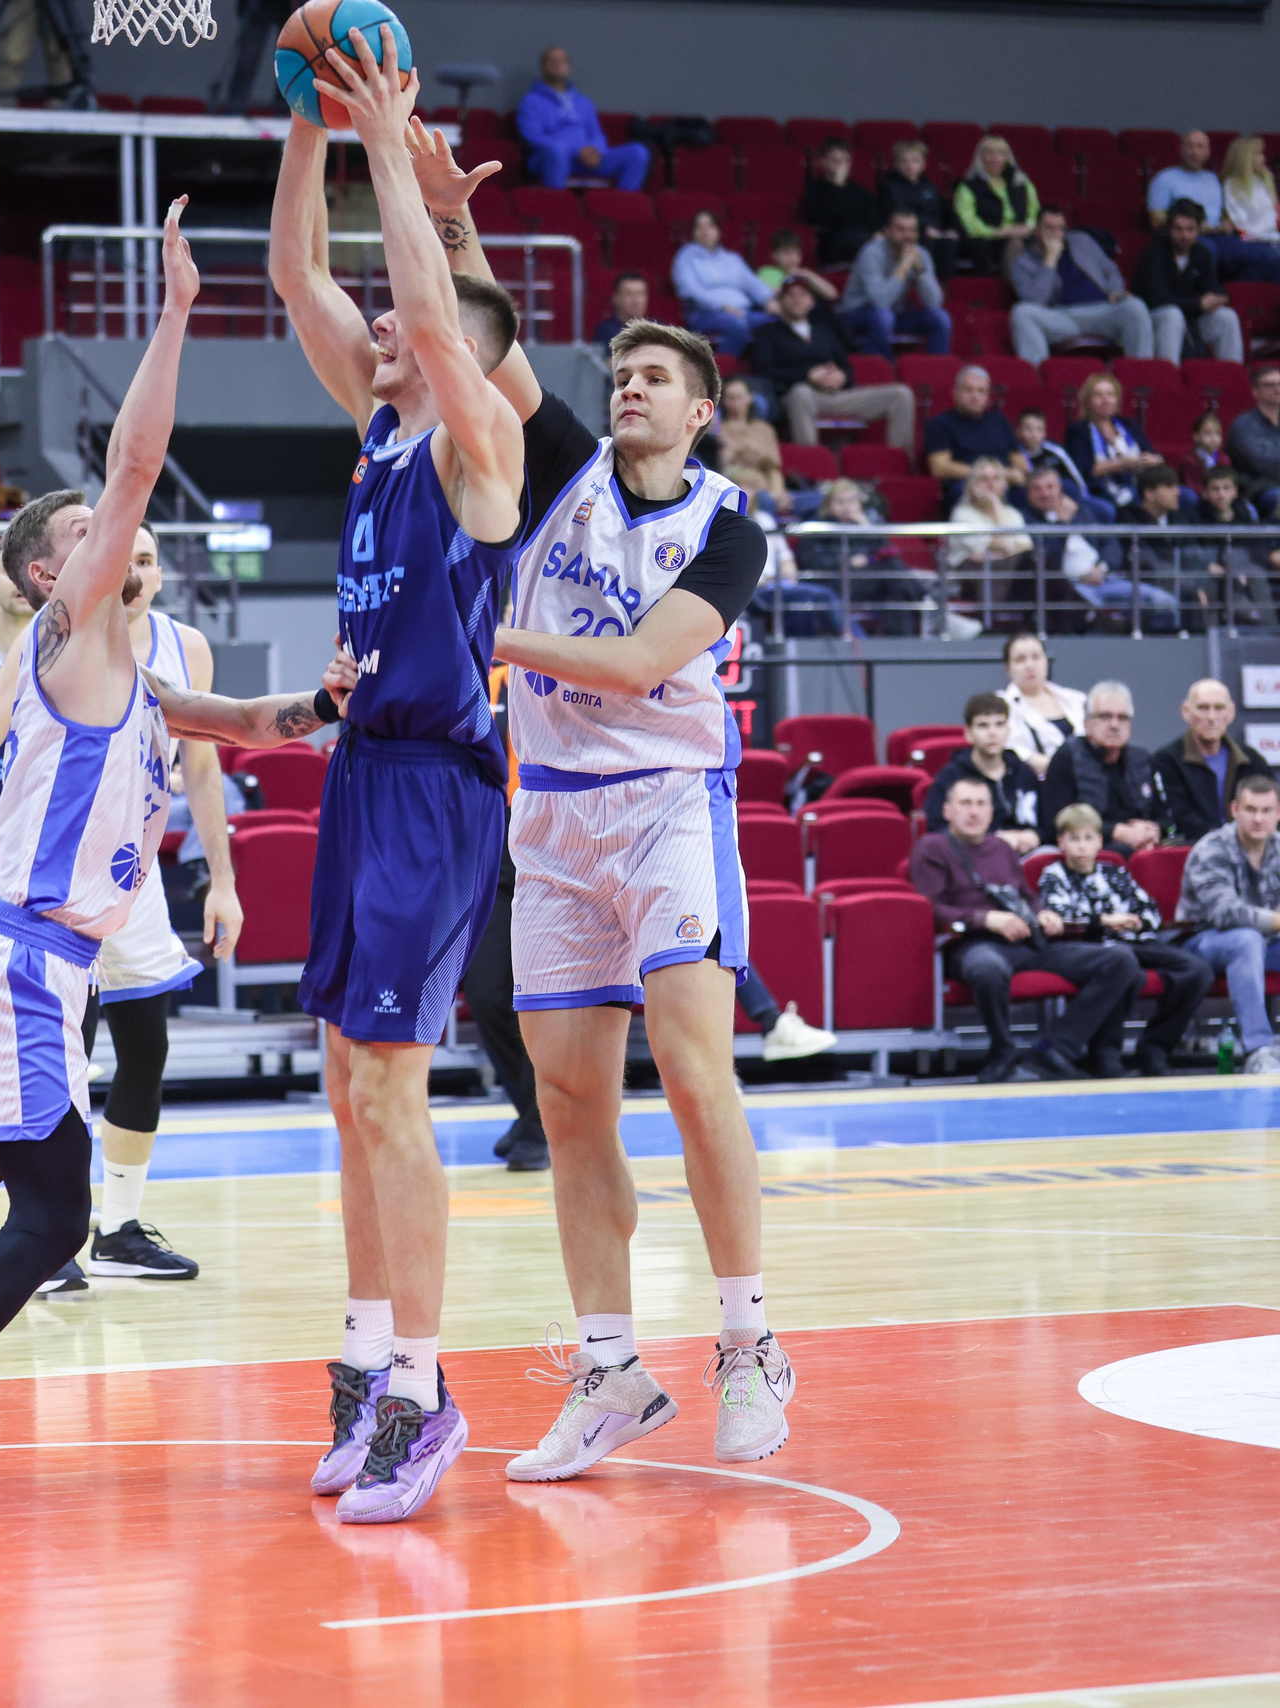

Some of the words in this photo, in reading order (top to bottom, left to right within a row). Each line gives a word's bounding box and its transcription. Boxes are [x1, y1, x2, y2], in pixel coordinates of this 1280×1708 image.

[542, 541, 659, 627] SAMAR
[563, 689, 602, 708] ВОЛГА
[373, 1005, 402, 1014] KELME
